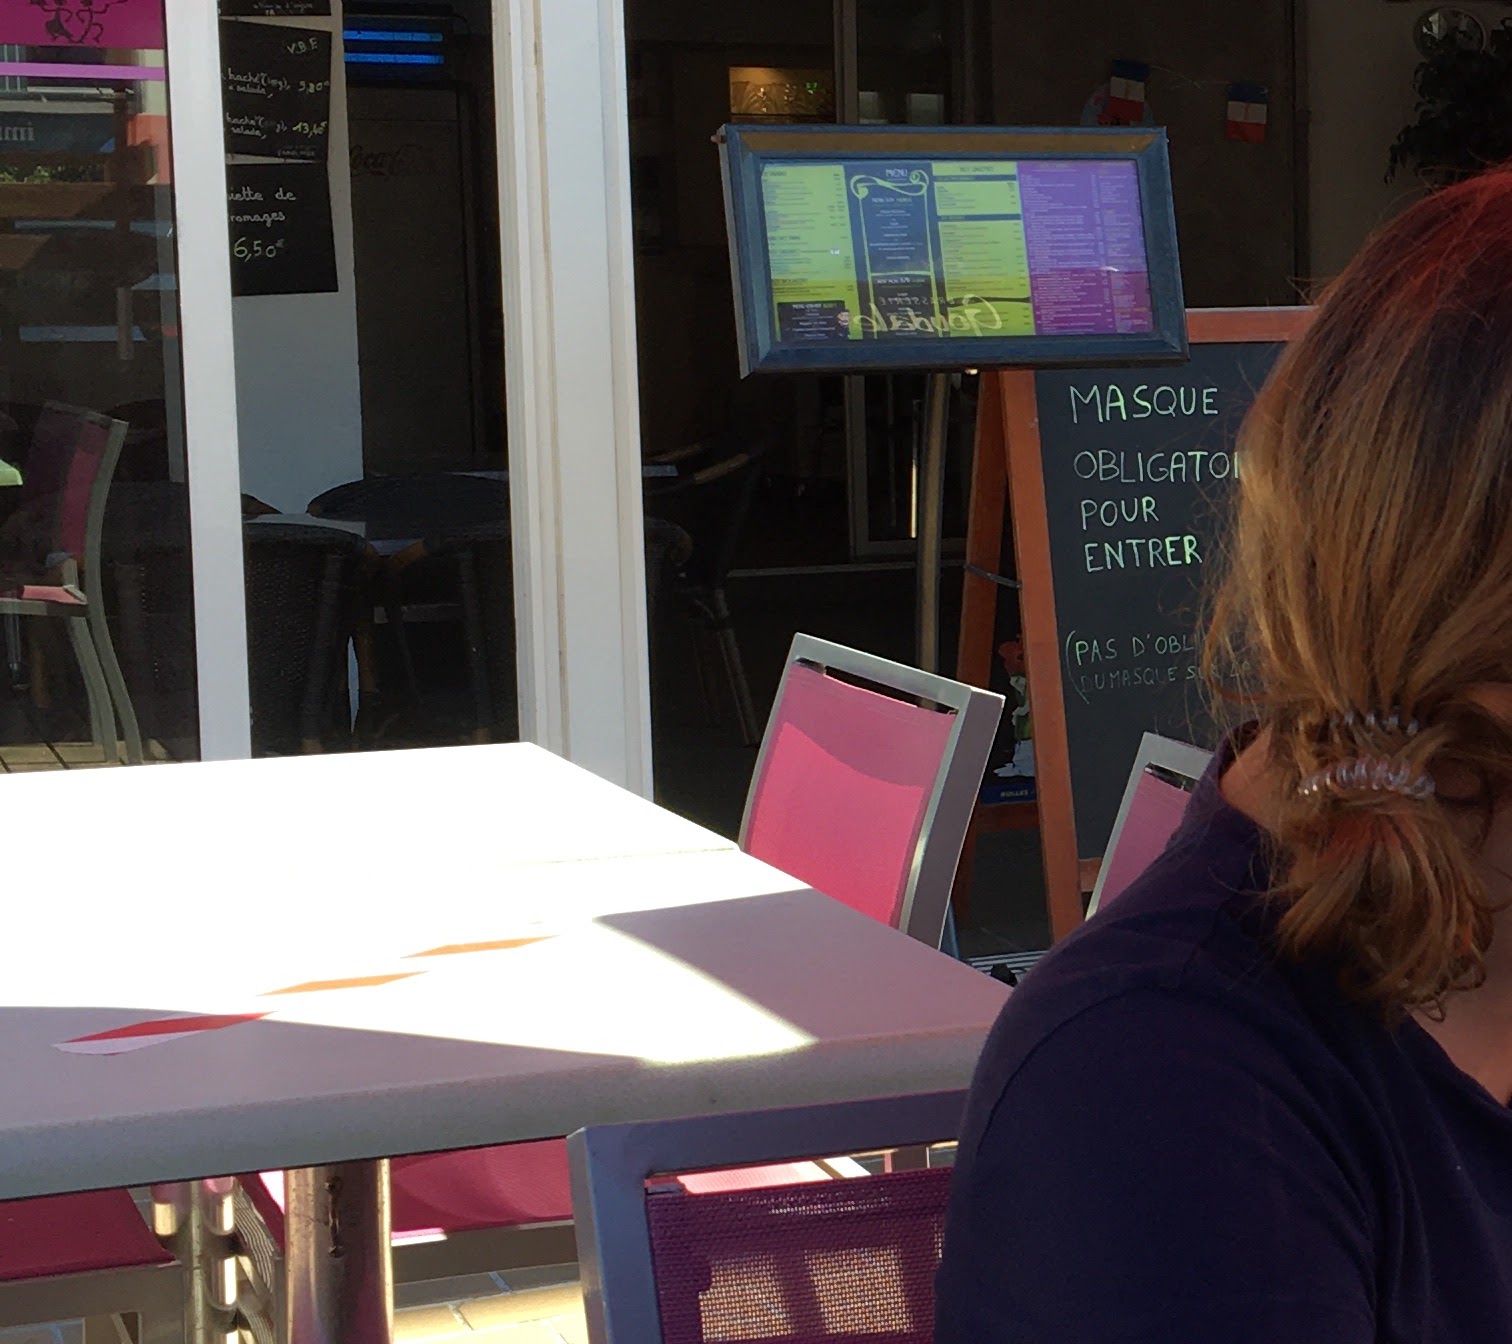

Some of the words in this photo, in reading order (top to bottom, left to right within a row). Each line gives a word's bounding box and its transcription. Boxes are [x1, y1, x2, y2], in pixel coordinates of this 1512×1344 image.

[275, 187, 296, 201] de
[229, 210, 286, 228] romages
[1069, 384, 1219, 424] MASQUE
[1073, 448, 1240, 484] OBLIGATOI
[1080, 495, 1160, 531] POUR
[1084, 534, 1203, 573] ENTRER
[1131, 632, 1195, 658] D'OBL
